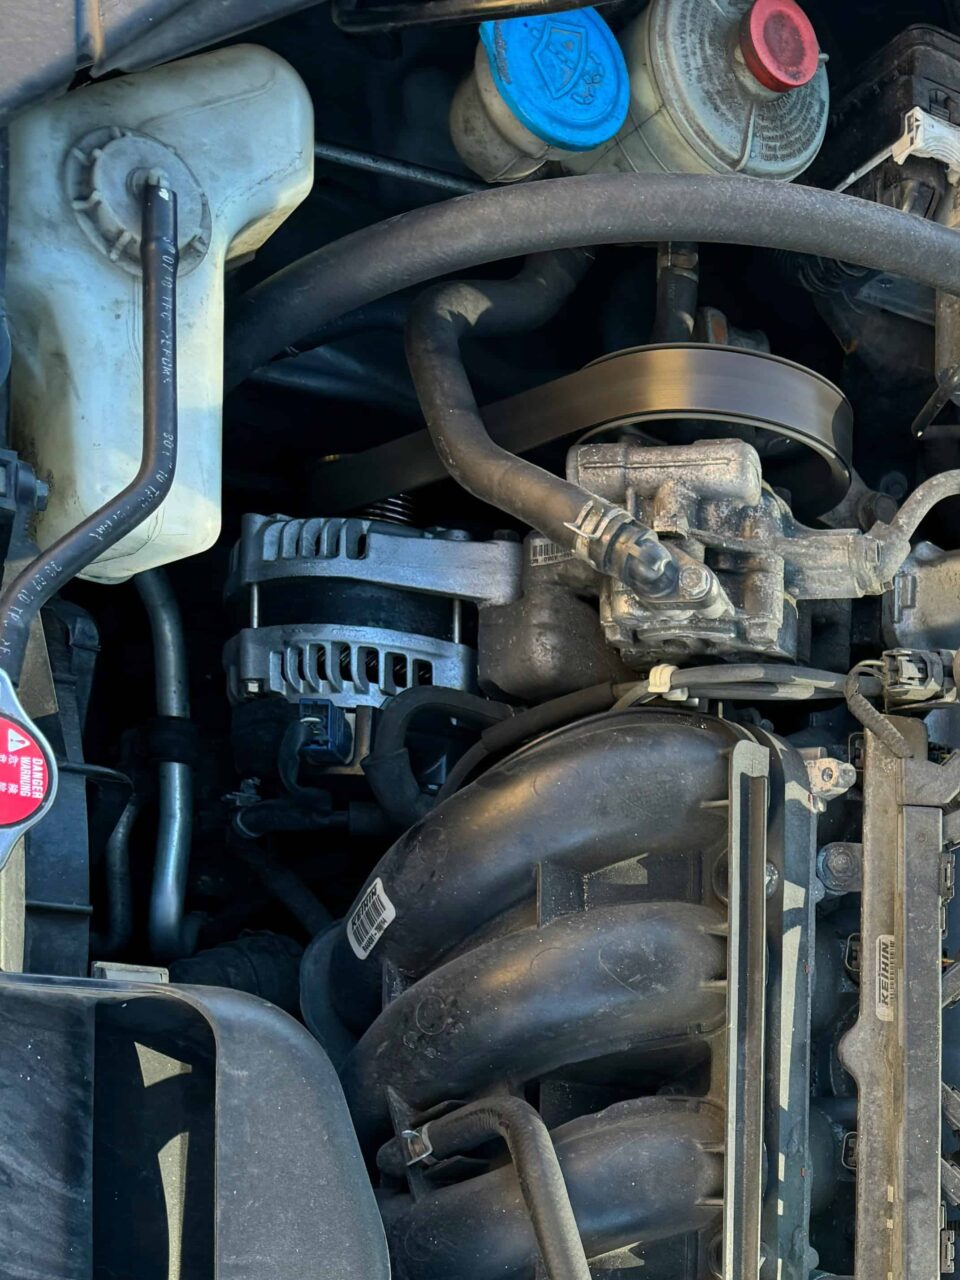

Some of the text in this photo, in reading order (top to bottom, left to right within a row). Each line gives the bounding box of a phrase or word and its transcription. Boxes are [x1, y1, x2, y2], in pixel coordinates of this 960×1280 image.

[19, 756, 30, 797] WARNUNG
[31, 757, 43, 798] DANGER
[881, 940, 889, 1005] KEIHIN
